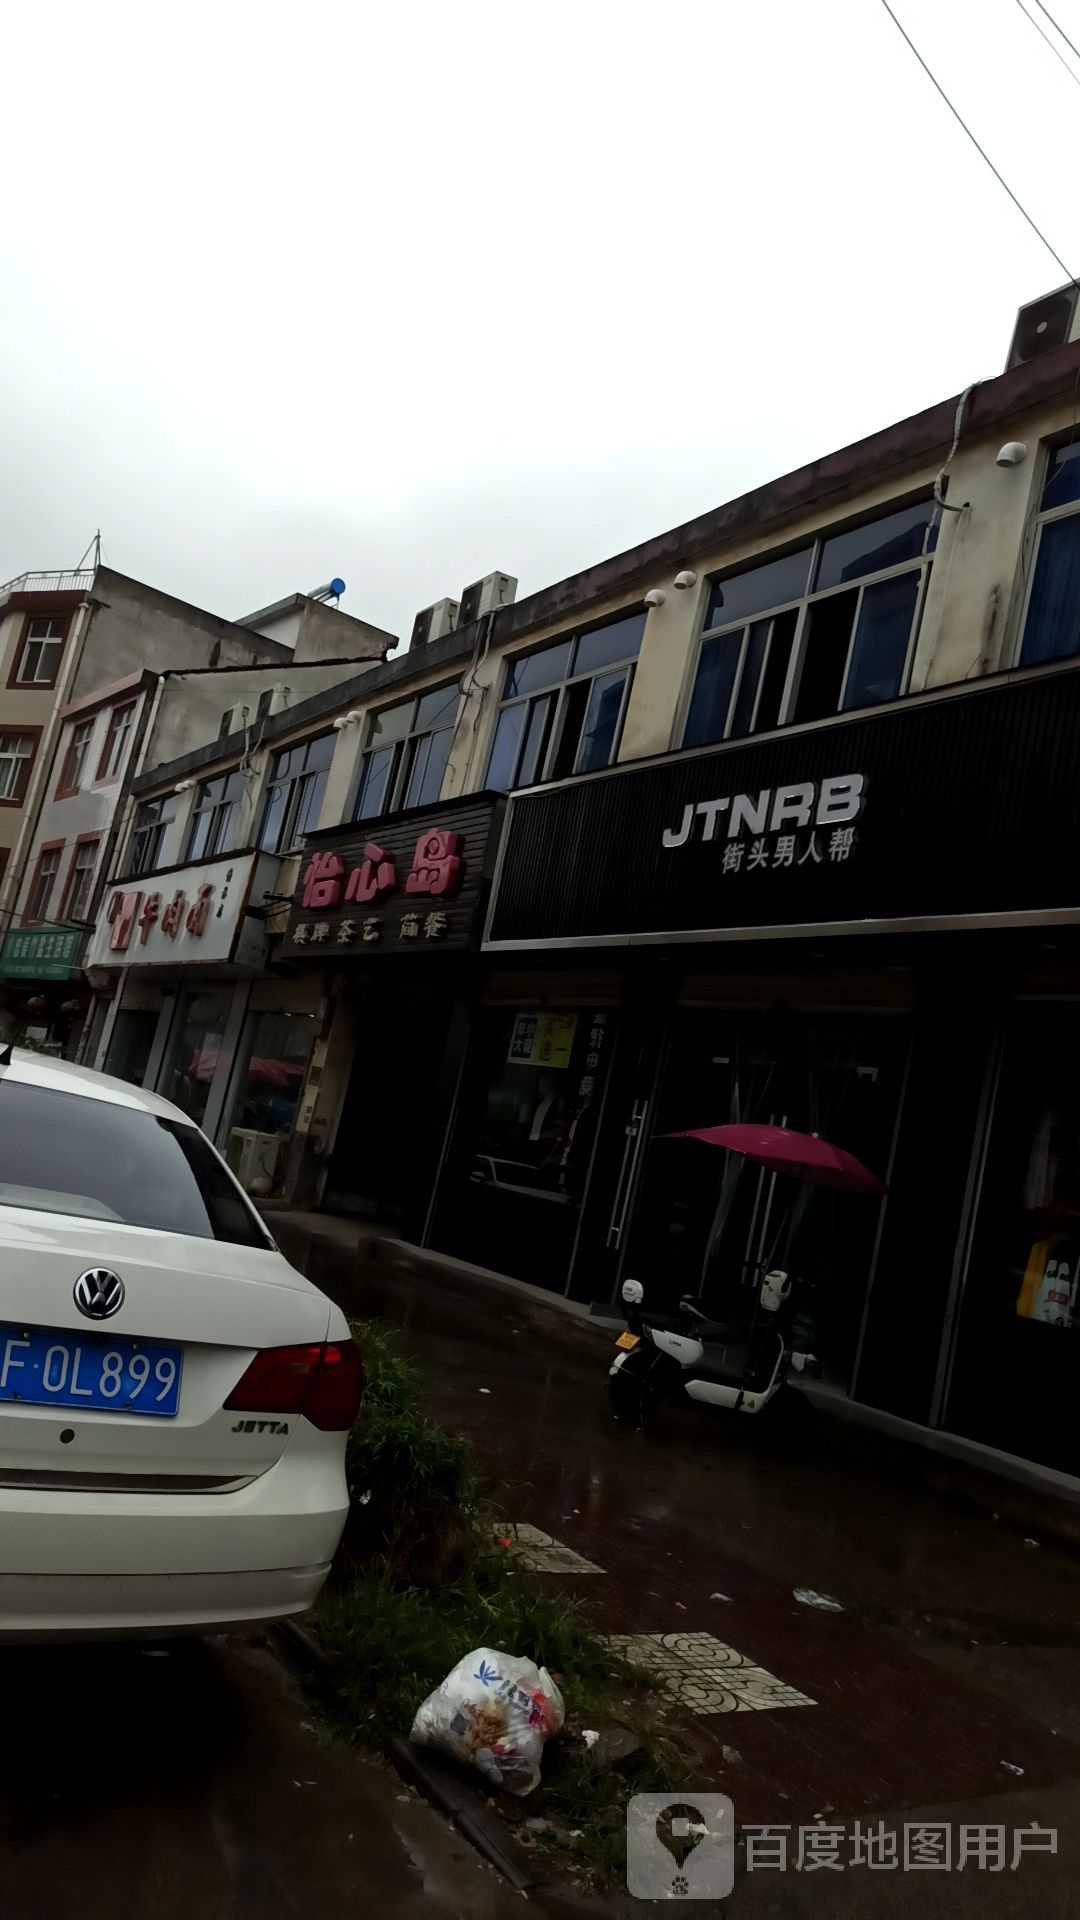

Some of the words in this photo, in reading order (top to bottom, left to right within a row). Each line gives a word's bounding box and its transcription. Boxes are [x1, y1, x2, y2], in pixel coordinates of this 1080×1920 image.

[662, 773, 864, 848] JTNRB
[302, 828, 461, 910] 怡心岛
[721, 826, 856, 875] 街头男人帮
[231, 1419, 290, 1436] JETTA
